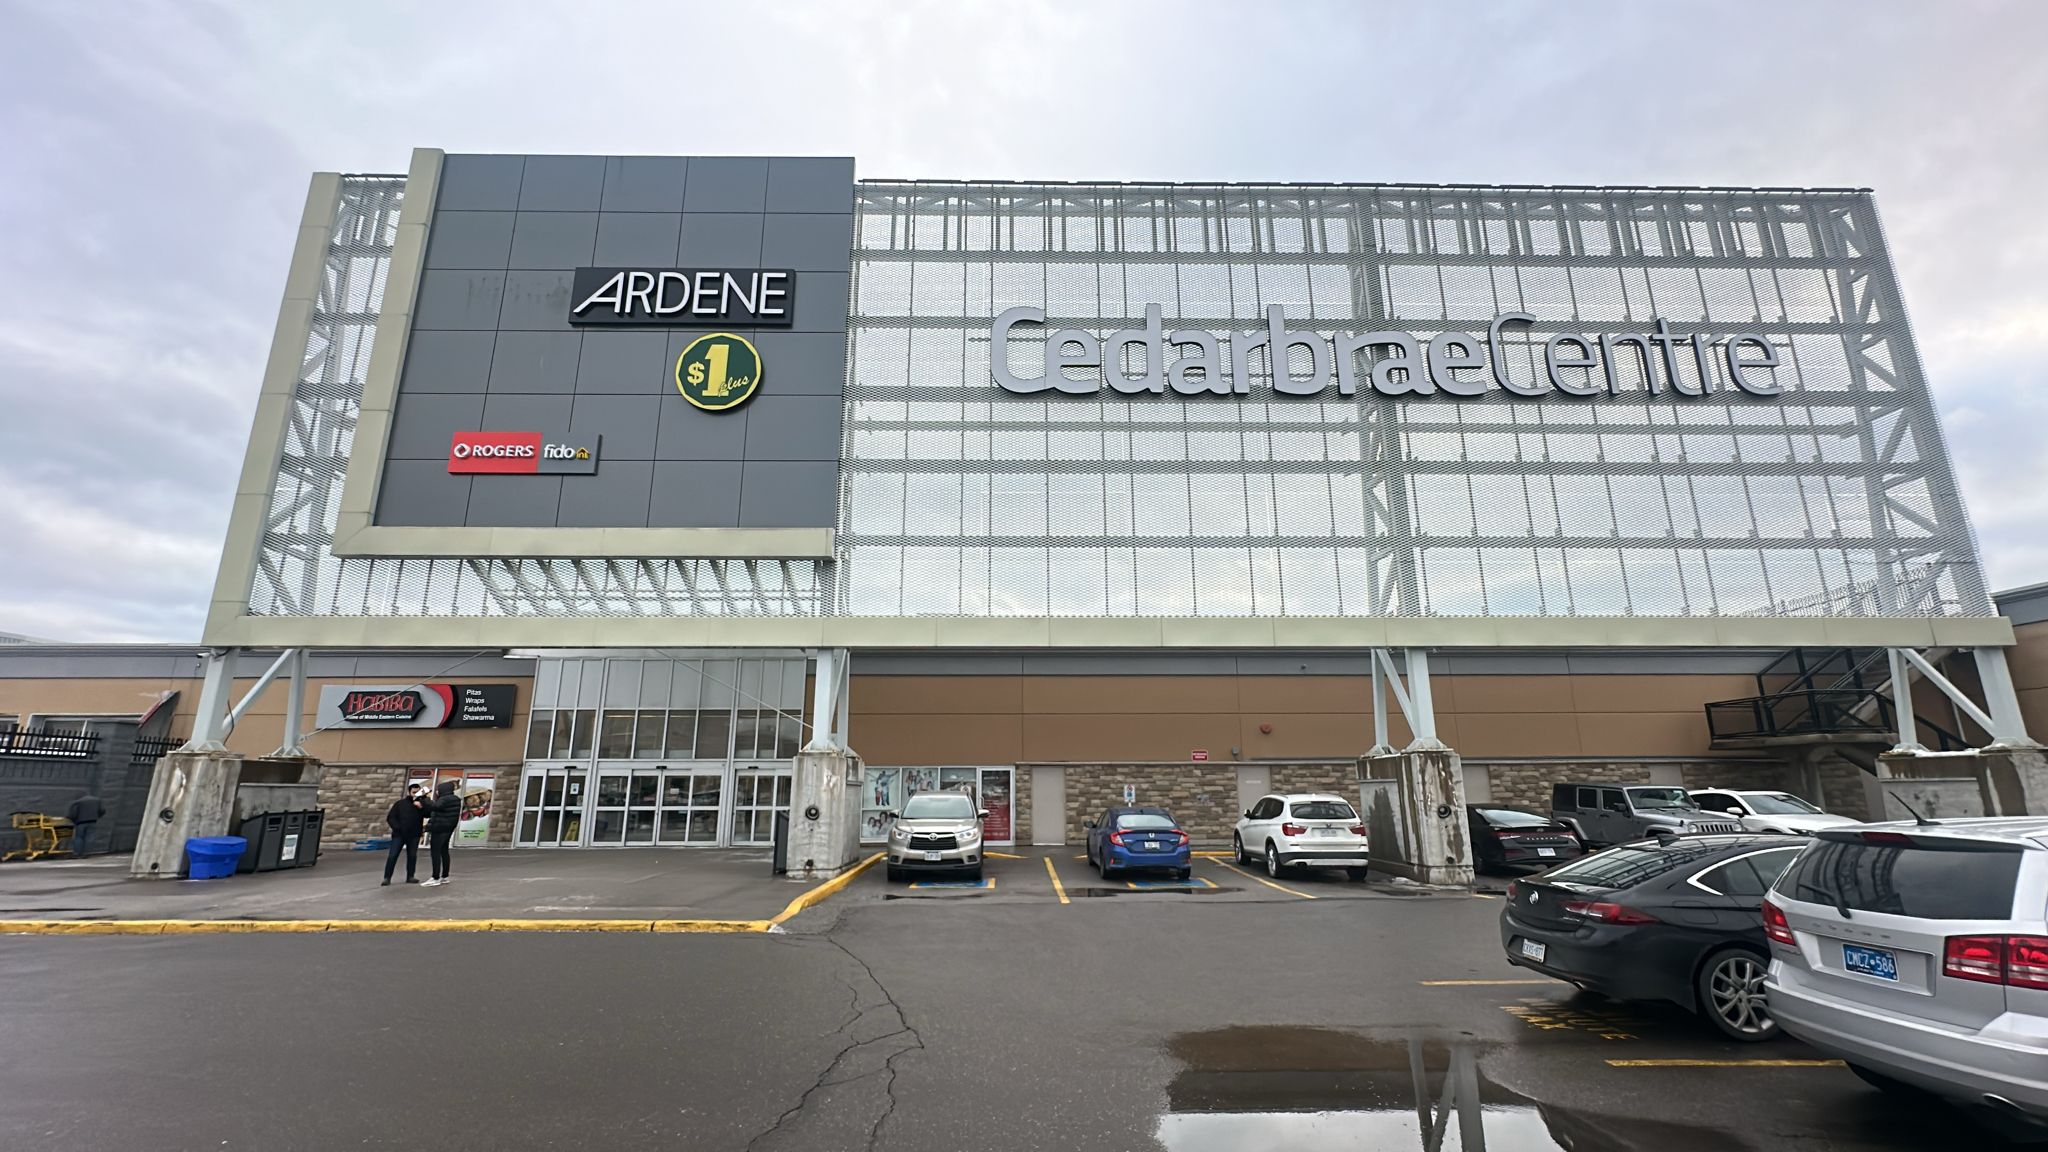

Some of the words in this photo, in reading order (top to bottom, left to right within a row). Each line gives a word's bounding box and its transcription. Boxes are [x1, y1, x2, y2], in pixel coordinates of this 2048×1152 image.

[573, 271, 788, 315] ARDENE
[472, 444, 535, 457] ROGERS
[543, 443, 576, 459] fido
[465, 697, 485, 705] Wraps
